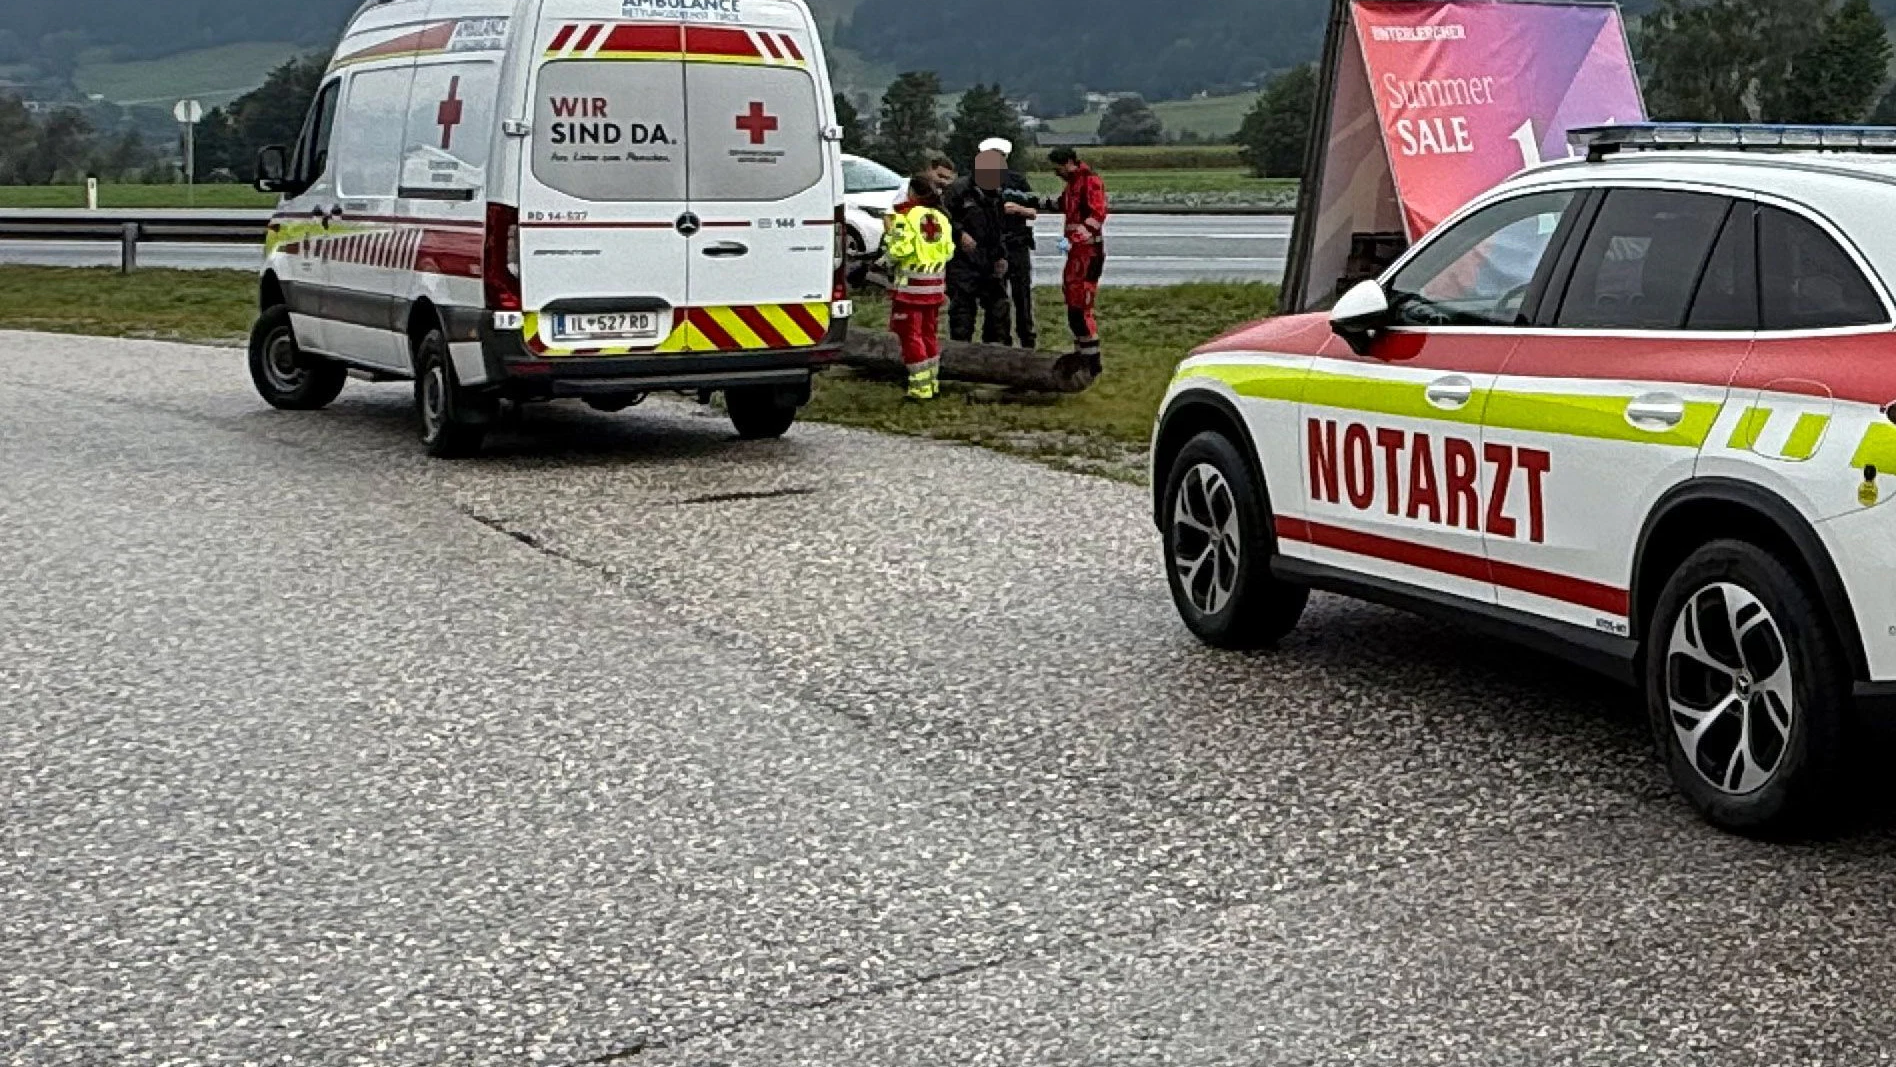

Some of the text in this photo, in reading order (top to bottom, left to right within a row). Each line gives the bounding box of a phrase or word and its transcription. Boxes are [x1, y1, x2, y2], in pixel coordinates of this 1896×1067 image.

[1382, 72, 1495, 109] Summer
[549, 97, 608, 118] WIR
[550, 122, 677, 145] SIND DA.
[1396, 115, 1475, 157] SALE
[527, 211, 545, 221] RD
[571, 313, 649, 332] IL 527 RD
[1305, 416, 1551, 544] NOTARZT
